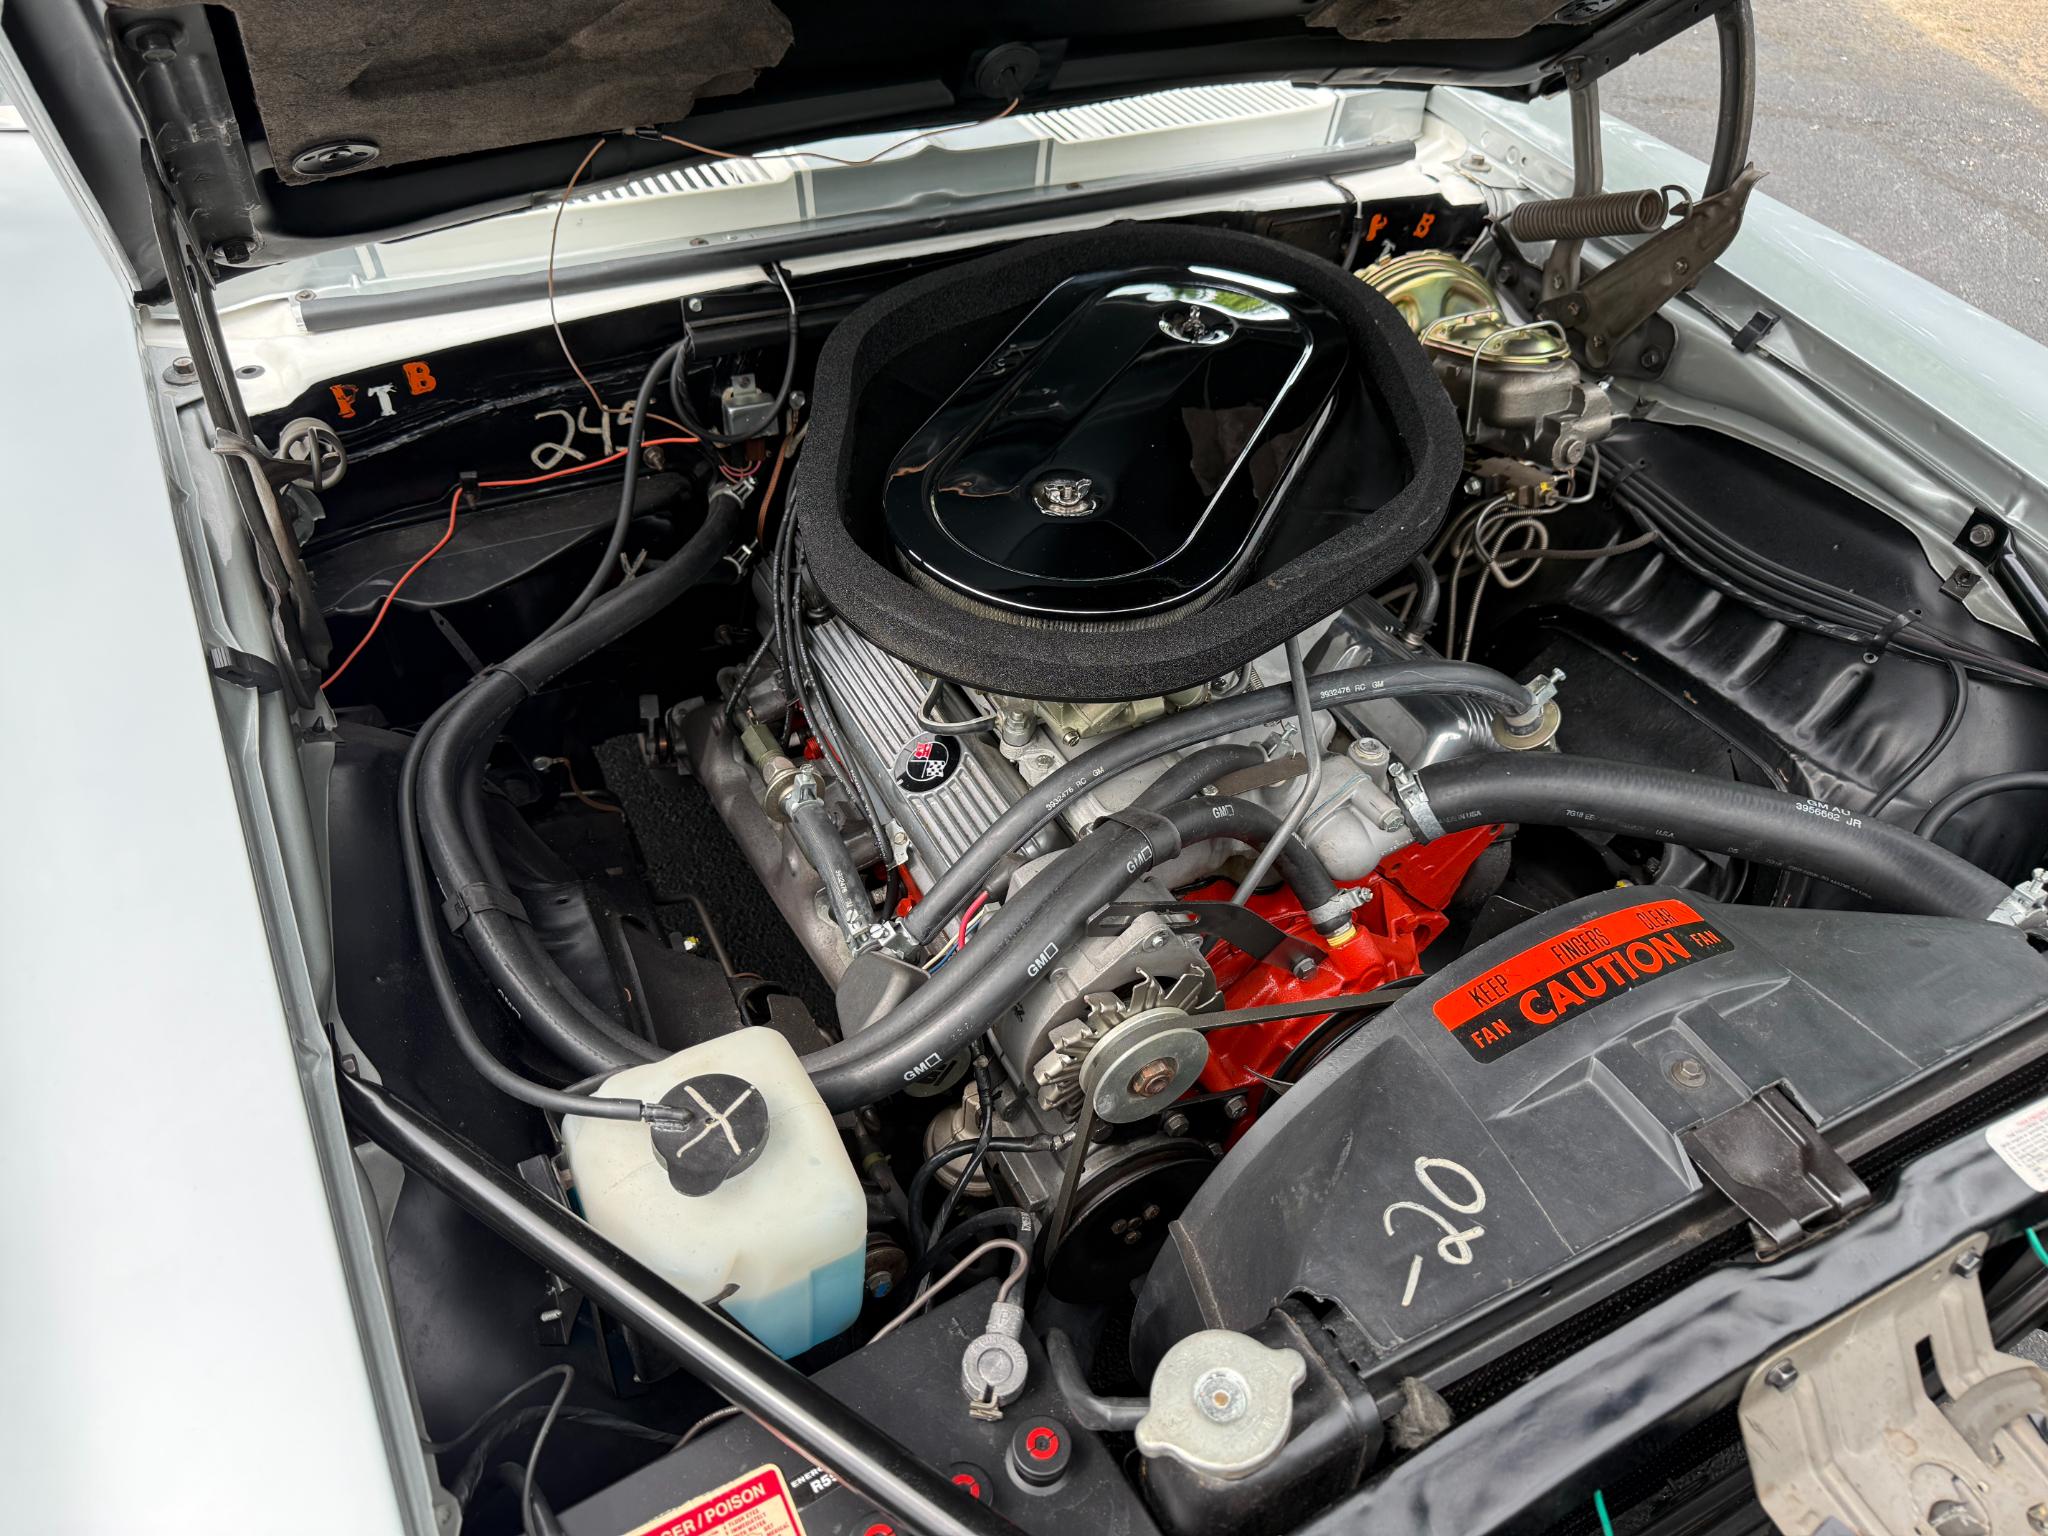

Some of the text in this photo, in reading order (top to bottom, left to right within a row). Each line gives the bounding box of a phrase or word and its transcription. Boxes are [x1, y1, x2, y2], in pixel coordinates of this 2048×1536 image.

[1319, 680, 1385, 699] 3932476 RC GM
[1045, 766, 1105, 811] 3932476 RC GM
[1807, 800, 1851, 816] GM AU
[1846, 817, 1862, 829] JR
[1468, 907, 1677, 1008] KEEP FINGERS CLEAR
[1470, 930, 1721, 1050] FAN CAUTION FAN
[704, 1482, 766, 1523] POISON
